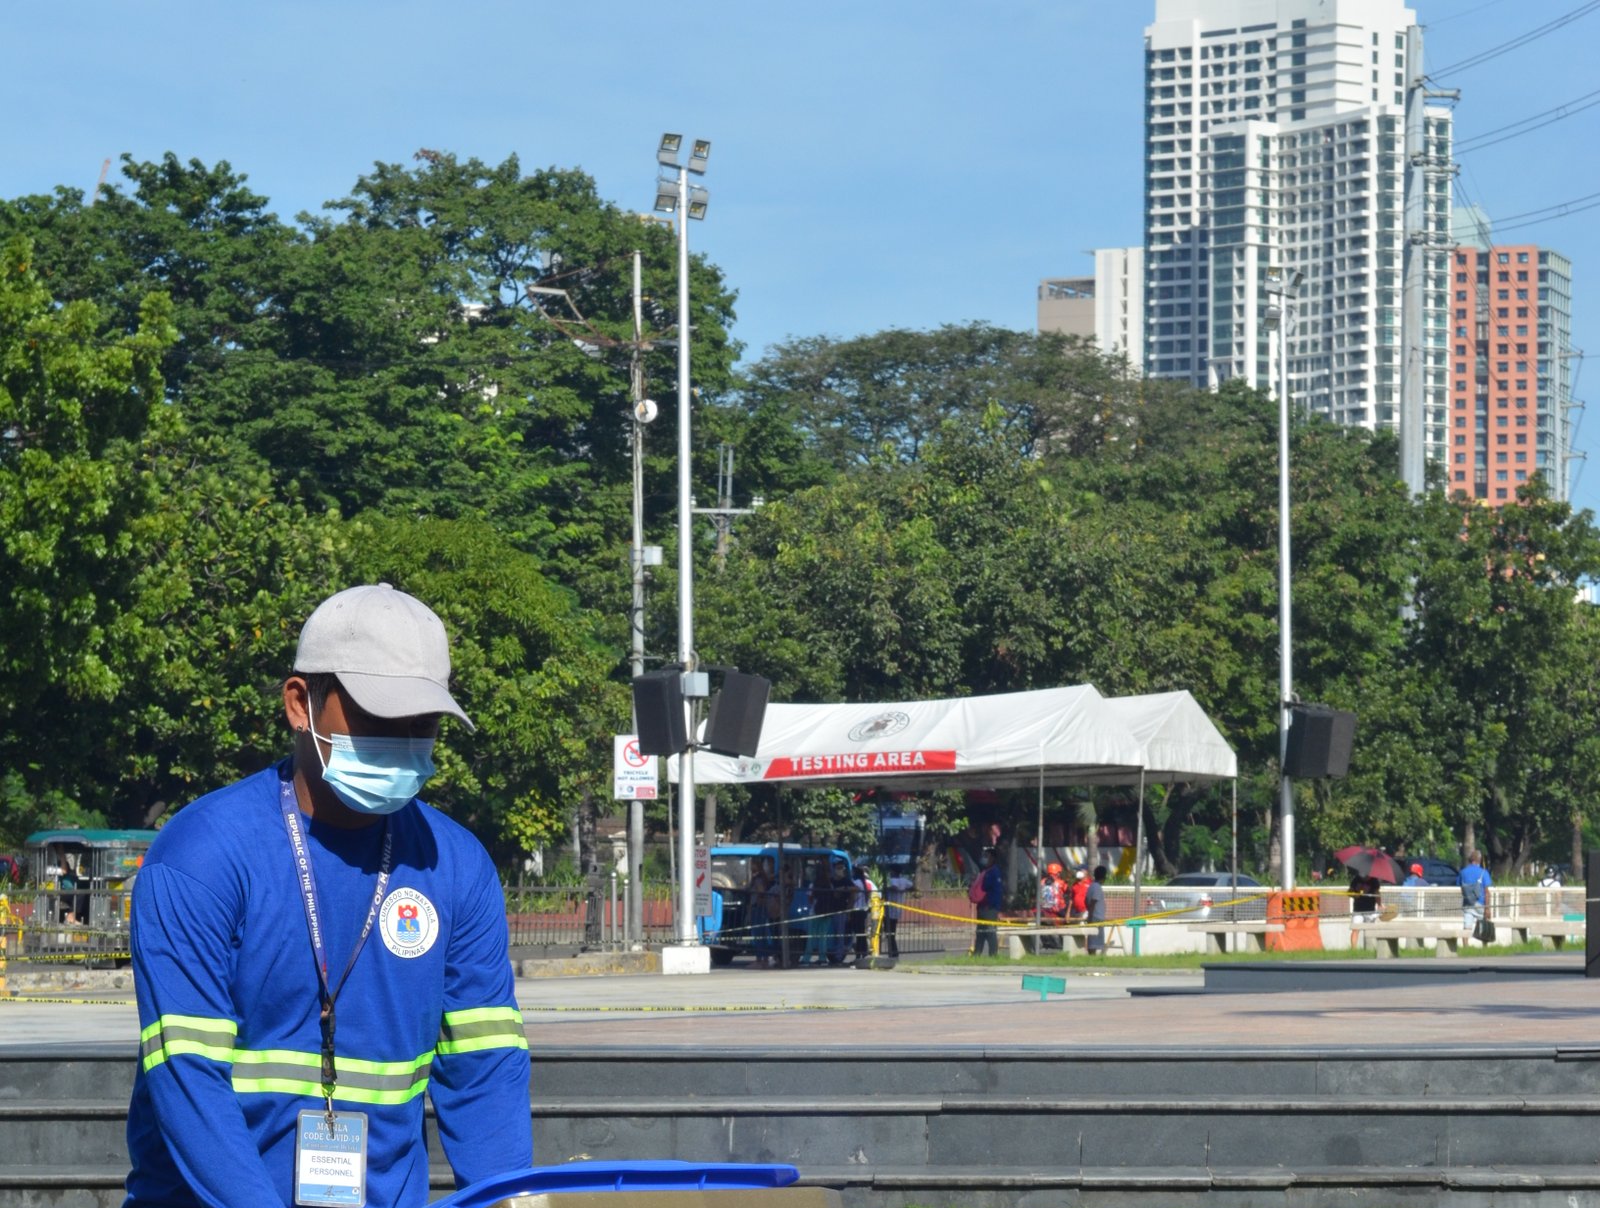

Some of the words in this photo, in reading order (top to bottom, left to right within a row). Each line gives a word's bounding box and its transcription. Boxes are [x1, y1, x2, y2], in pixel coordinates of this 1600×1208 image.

[790, 754, 868, 771] TESTING
[874, 752, 926, 767] AREA
[288, 813, 304, 856] REPUBLIC
[299, 858, 308, 872] OF
[379, 833, 393, 884] MANILA
[302, 872, 312, 891] THE
[374, 885, 385, 906] OF
[381, 891, 402, 923] LUNGSOD
[404, 890, 414, 898] NG
[414, 893, 436, 924] MAYNILA
[306, 893, 321, 948] PHILIPPINES
[361, 907, 377, 939] CITY
[391, 944, 426, 957] PILIPINAS
[303, 1131, 324, 1141] CODE
[311, 1155, 352, 1165] ESSENTIAL
[309, 1167, 354, 1177] PERSONNEL
